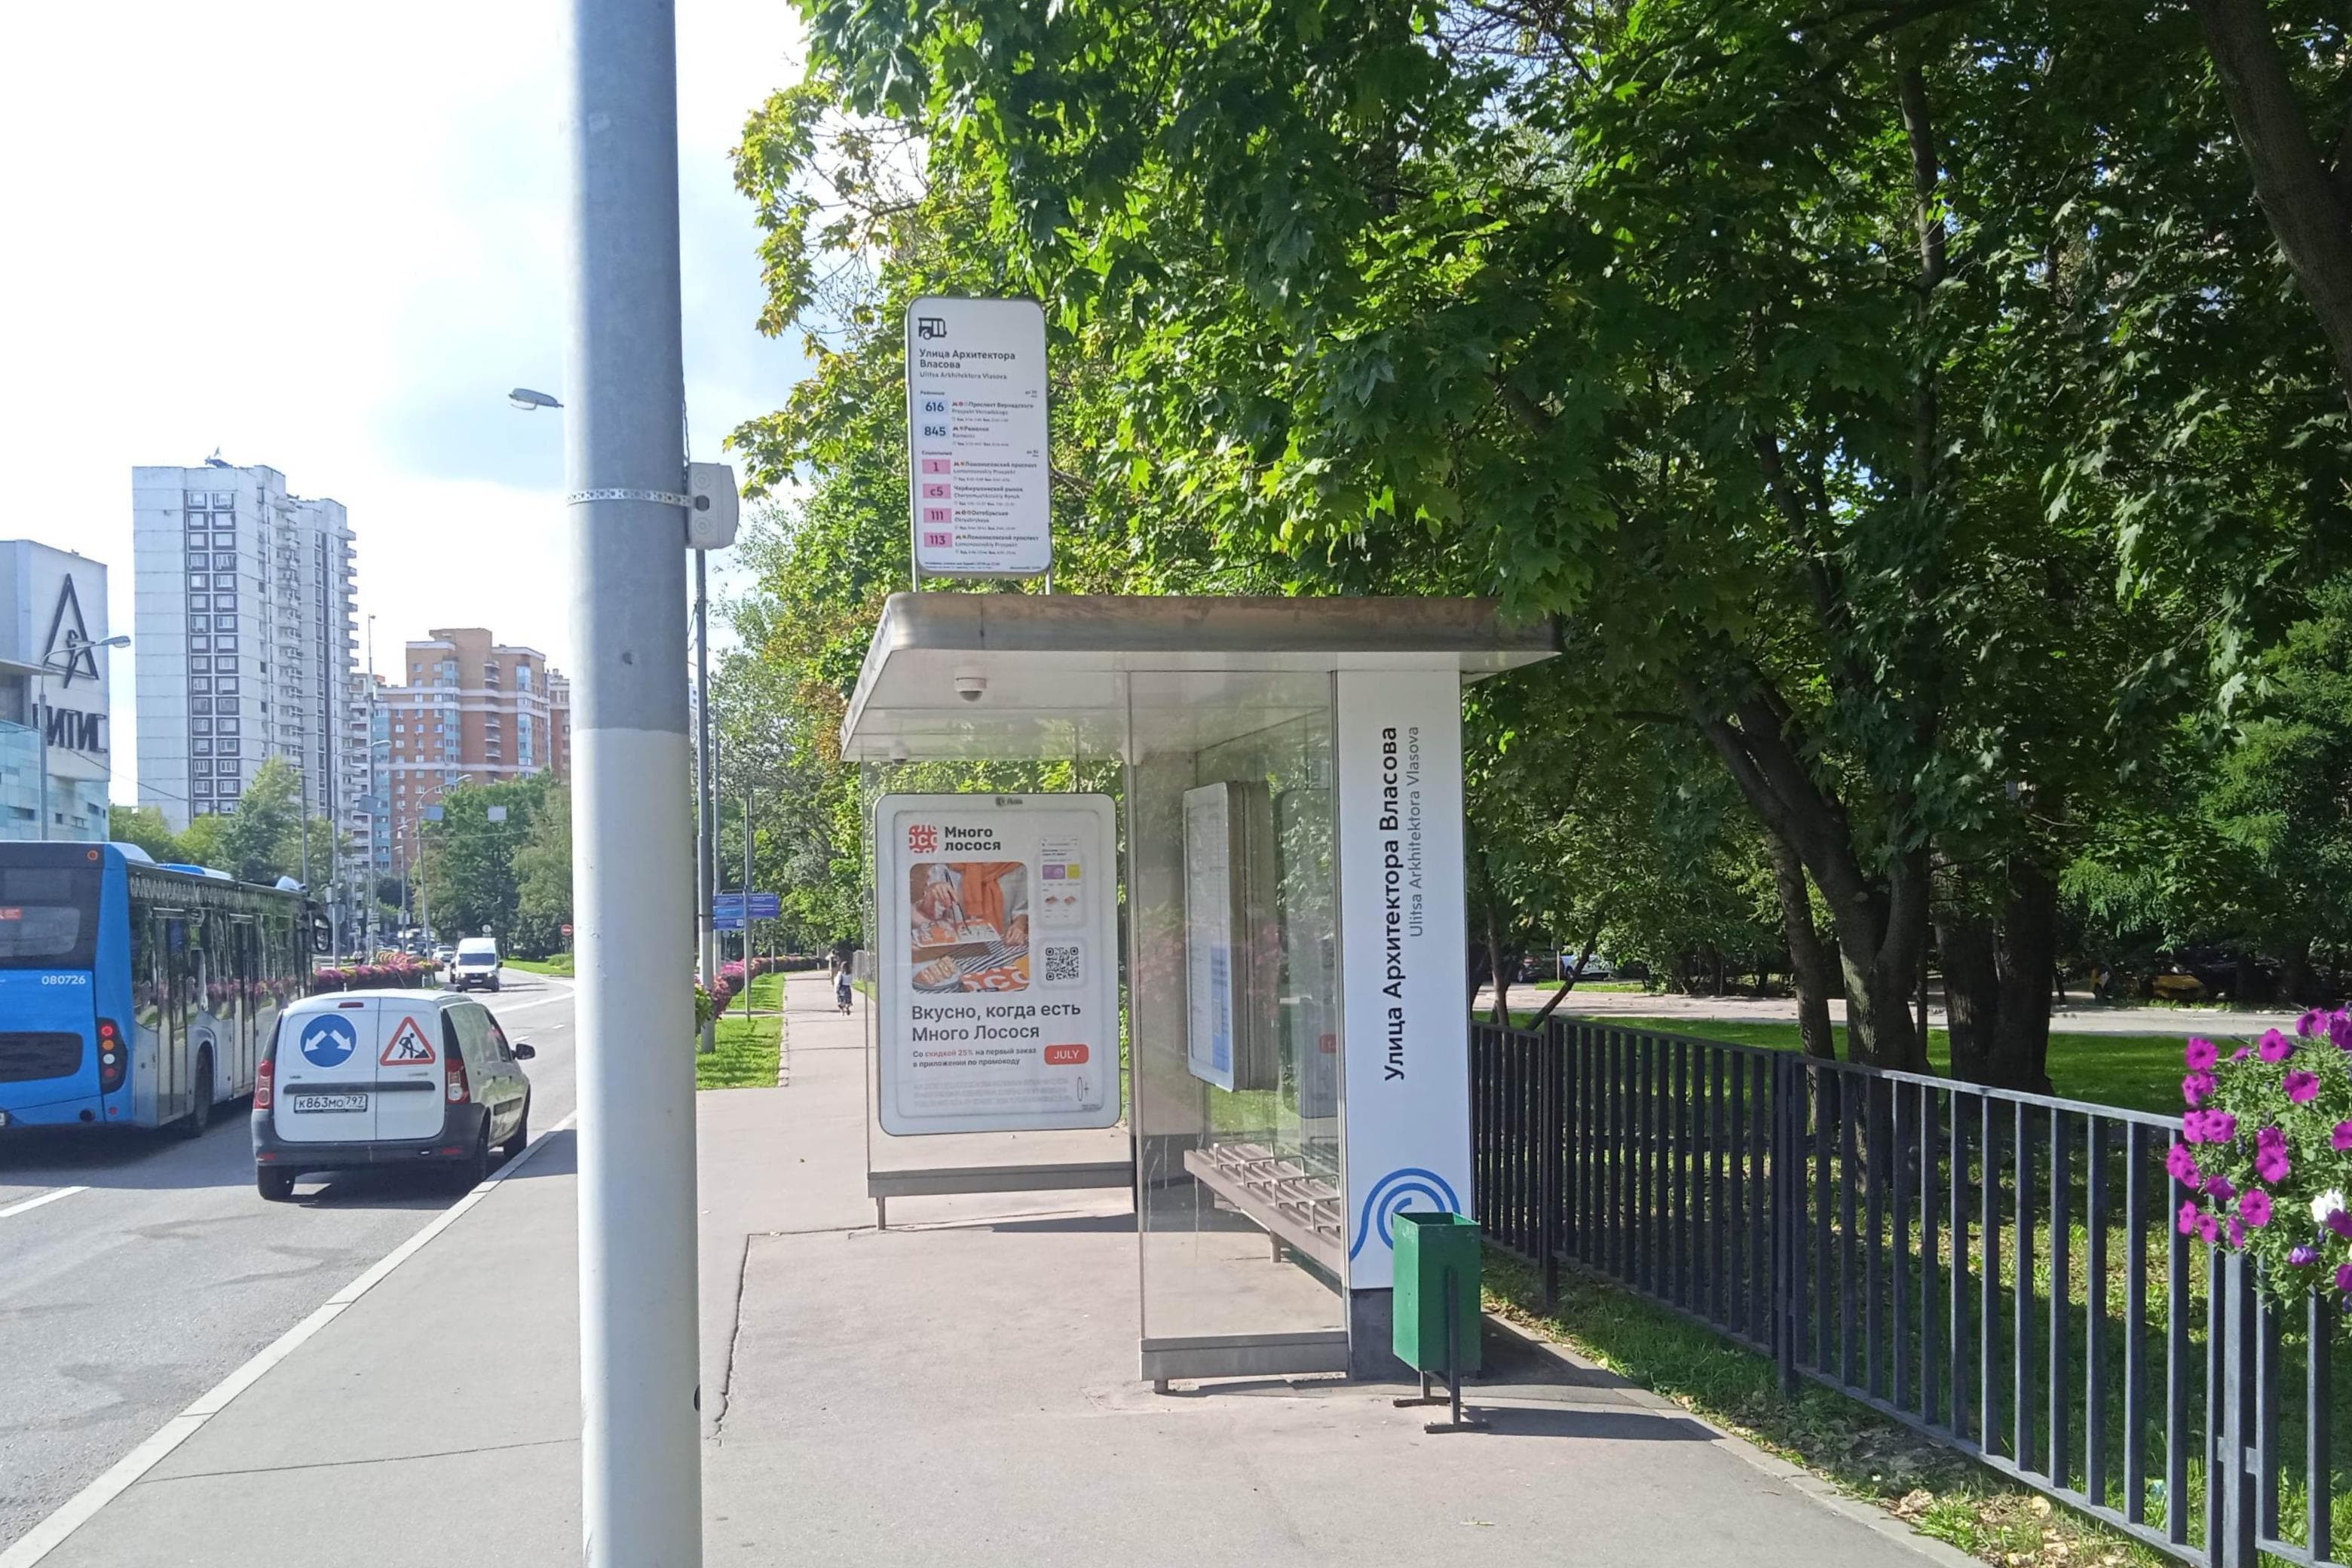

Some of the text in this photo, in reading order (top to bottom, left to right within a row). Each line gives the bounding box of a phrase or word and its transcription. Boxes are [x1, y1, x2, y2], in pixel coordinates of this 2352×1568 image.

[919, 348, 1015, 362] Улица Архитектора
[920, 359, 960, 369] Власова
[925, 401, 944, 412] 616
[924, 426, 946, 436] 845
[933, 461, 939, 472] 1
[931, 510, 944, 521] 111
[929, 535, 946, 546] 113
[945, 826, 993, 838] Много
[1407, 727, 1423, 937] Ulitsa Arkhitektora Vlasova
[945, 841, 1001, 851] лосося
[1380, 727, 1406, 1081] Улица Архитектора Власова
[41, 975, 86, 985] 080726
[911, 1003, 1081, 1022] Вкусно, когда есть
[912, 1025, 1040, 1042] Много Лосося
[925, 1049, 957, 1058] скидкой
[986, 1047, 1014, 1057] первый
[1054, 1050, 1080, 1060] JULY
[919, 1059, 966, 1070] приложении
[978, 1058, 1020, 1068] промокоду
[346, 1096, 363, 1106] 797
